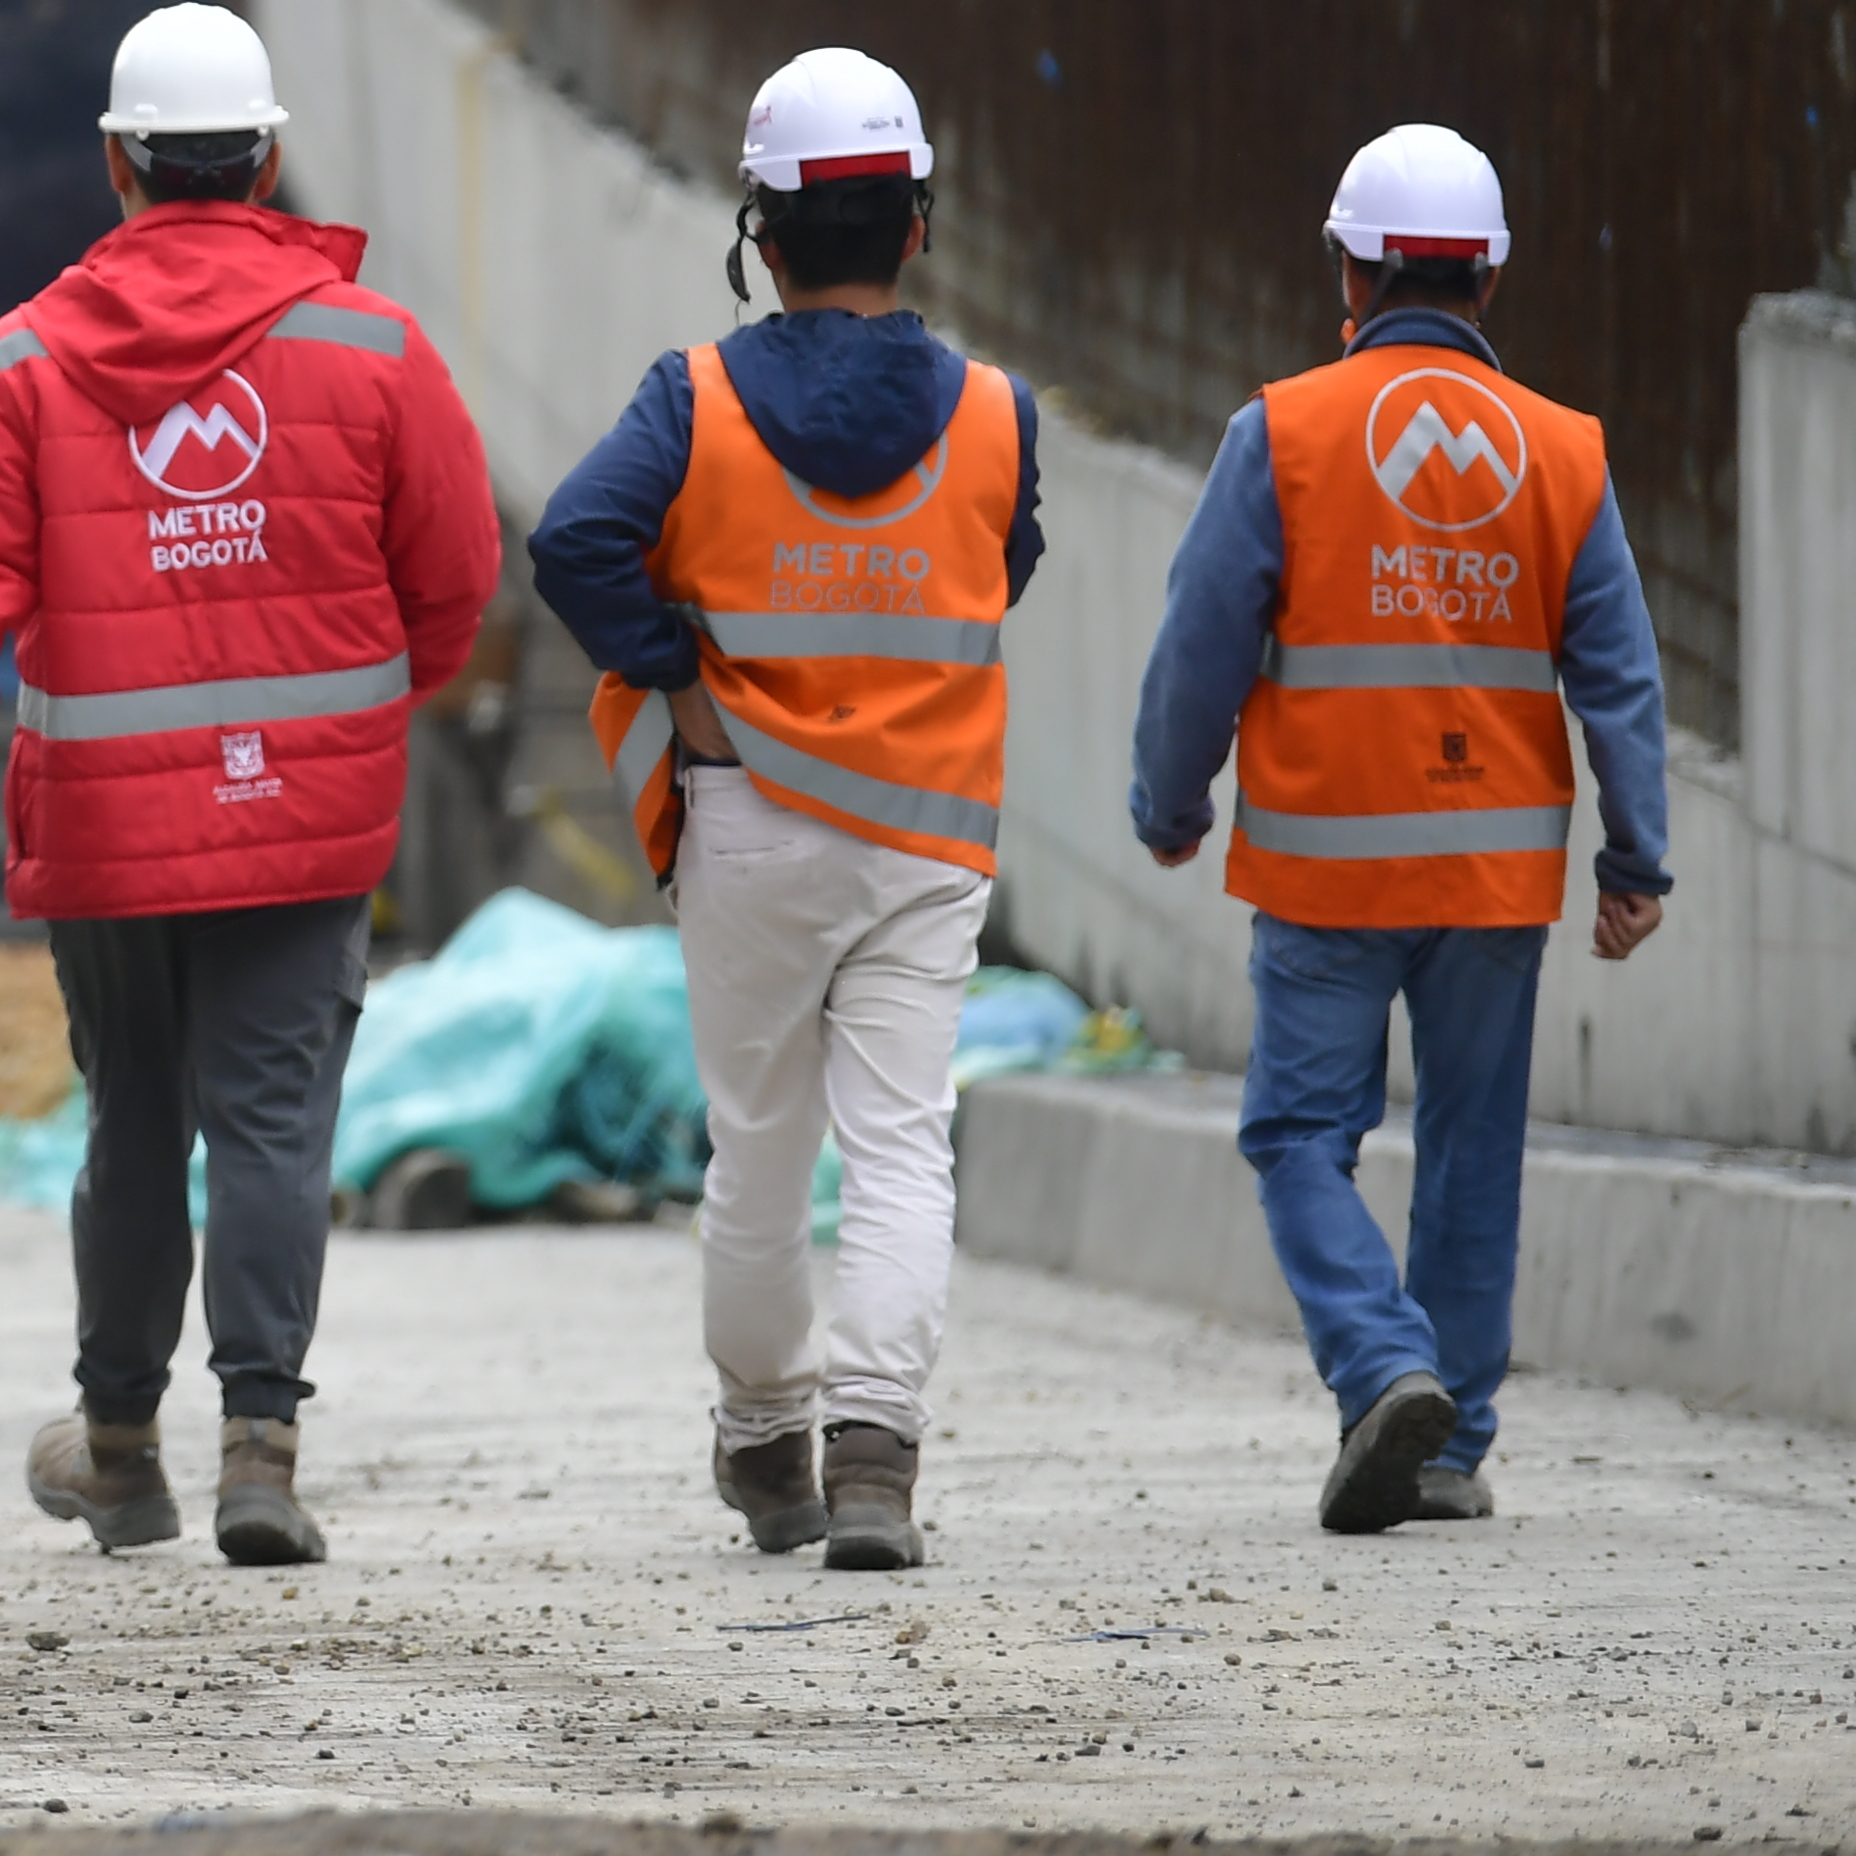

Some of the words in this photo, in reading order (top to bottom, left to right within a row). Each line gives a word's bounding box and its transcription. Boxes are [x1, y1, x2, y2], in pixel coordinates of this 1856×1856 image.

[148, 499, 267, 541] METRO
[151, 527, 269, 573] BOGOTÁ
[772, 541, 932, 582] METRO
[1371, 544, 1520, 587] METRO
[770, 578, 928, 616] BOGOTÁ
[1371, 584, 1513, 622] BOGOTÁ
